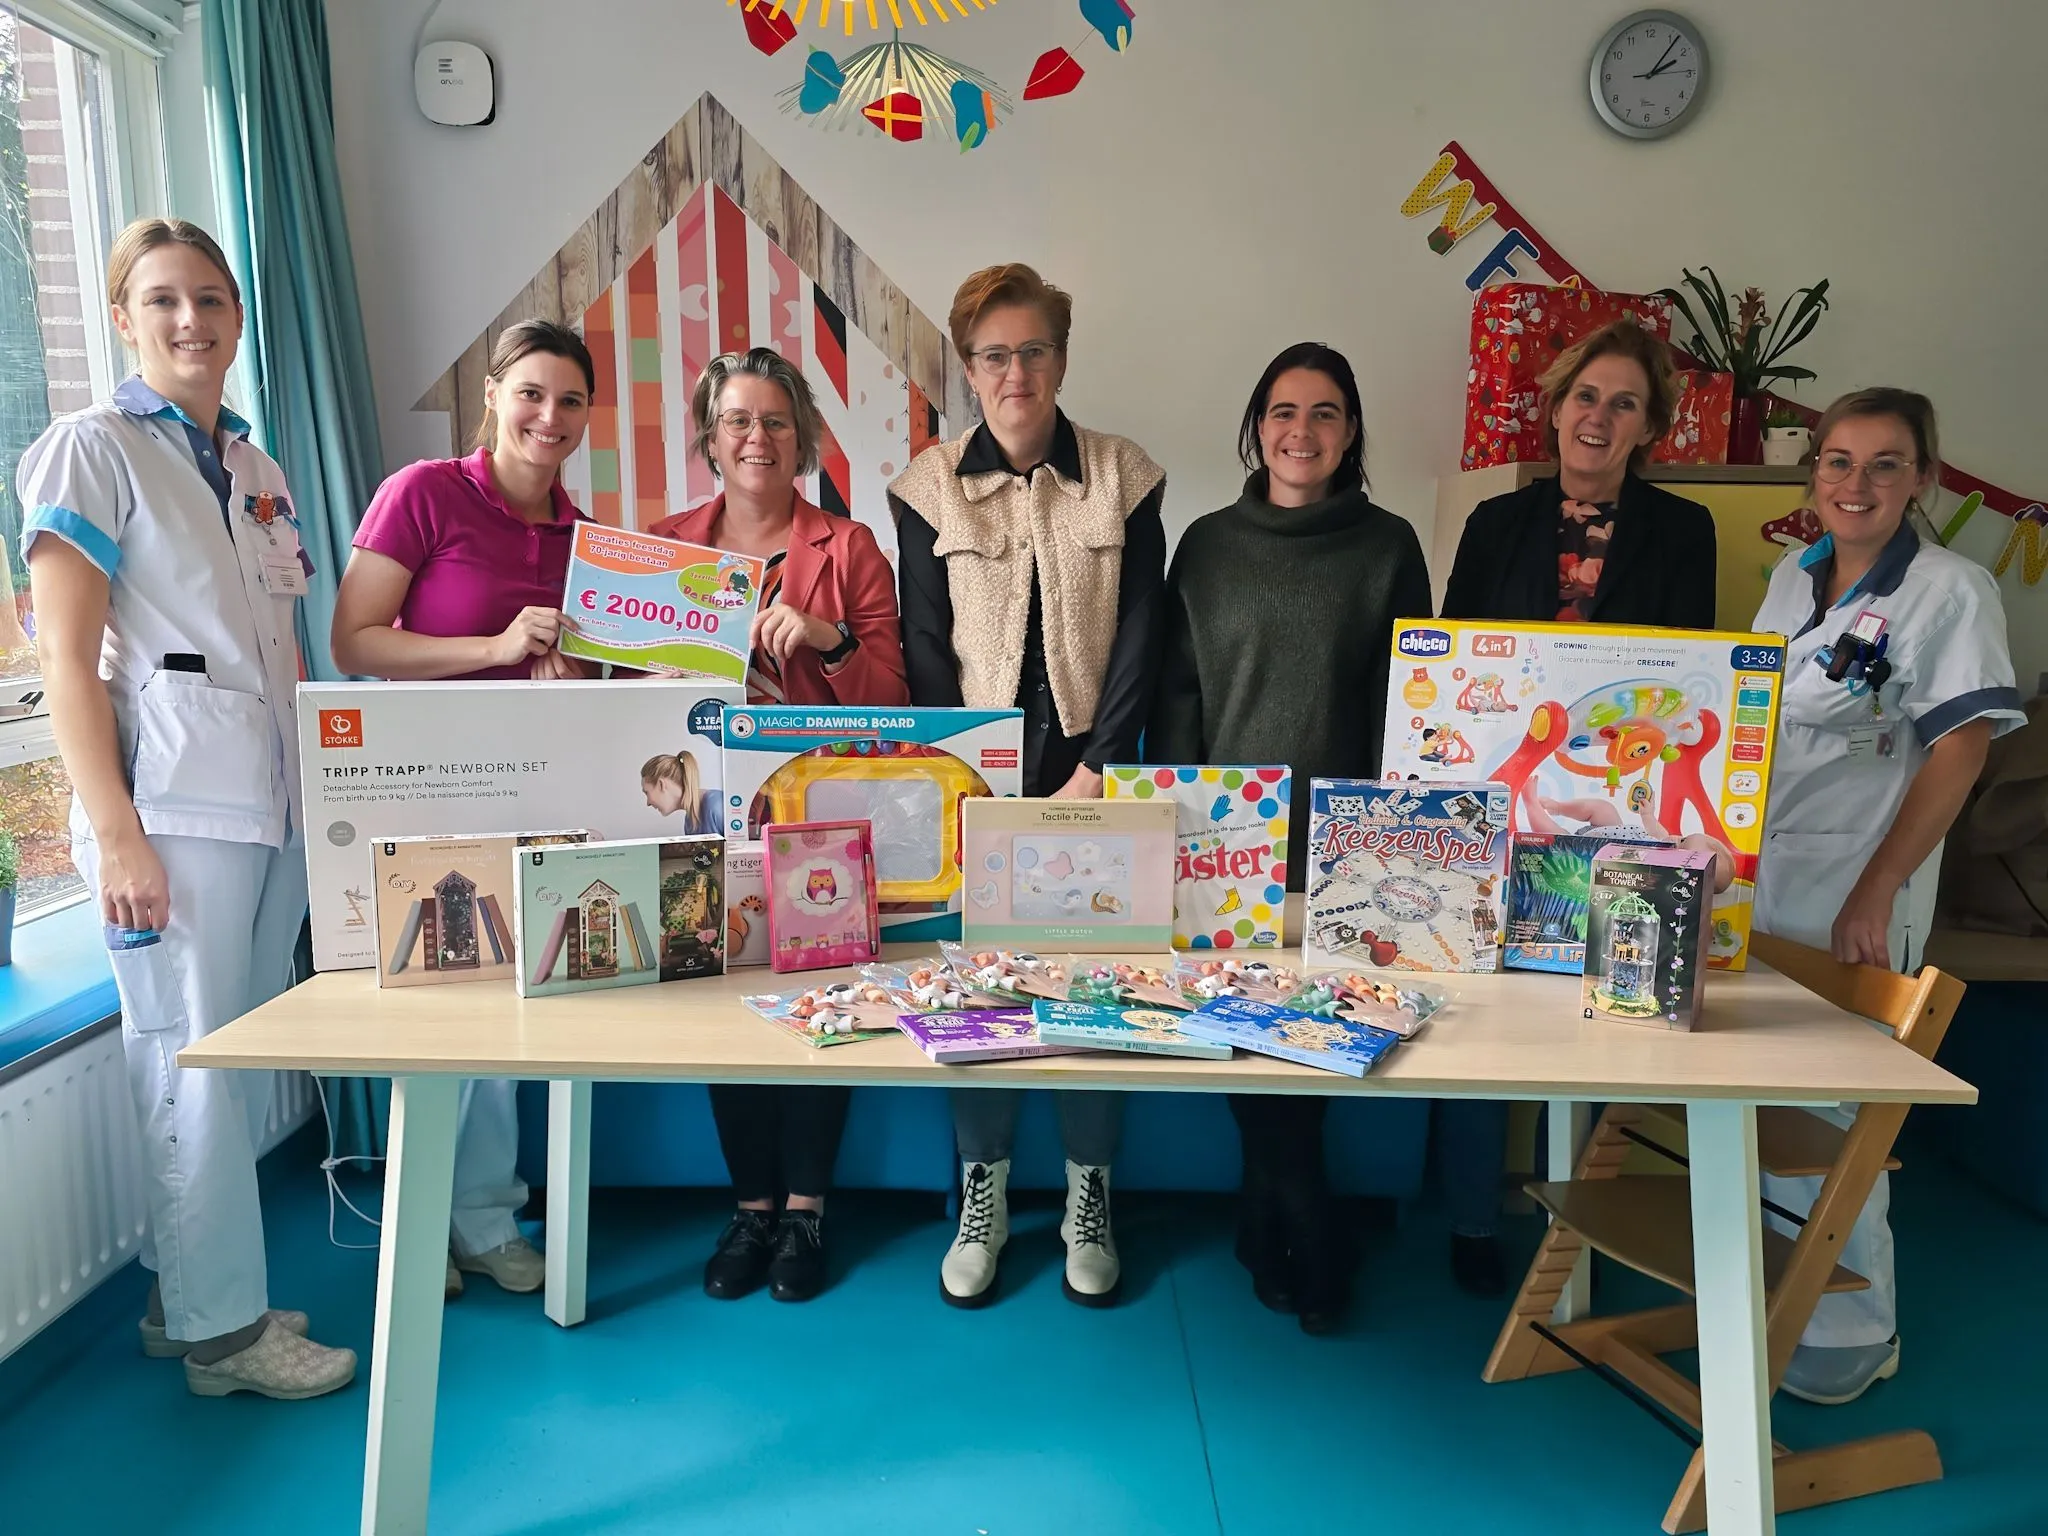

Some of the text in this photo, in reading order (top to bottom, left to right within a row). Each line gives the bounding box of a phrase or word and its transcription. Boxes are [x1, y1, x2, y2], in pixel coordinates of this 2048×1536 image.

[1645, 28, 1656, 38] 12
[1627, 36, 1636, 46] 11
[1667, 34, 1673, 43] 1
[1612, 51, 1623, 60] 10
[1680, 47, 1687, 57] 2
[1605, 73, 1612, 83] 9
[1686, 70, 1693, 79] 3
[1612, 94, 1619, 103] 8
[1678, 90, 1685, 99] 4
[1625, 108, 1632, 118] 7
[1664, 106, 1671, 116] 5
[1643, 113, 1650, 123] 6
[586, 530, 675, 558] Donaties feestdag
[590, 544, 668, 568] 70-jarig bestaan
[683, 584, 745, 609] De Flipjes
[579, 588, 720, 635] € 2000,00
[578, 615, 590, 624] Ten
[591, 617, 606, 627] bate
[1401, 633, 1448, 652] chicco
[1476, 637, 1513, 655] 4 in 1
[1553, 642, 1588, 650] GROWING
[1589, 644, 1616, 654] through
[1617, 645, 1631, 655] play
[1558, 655, 1584, 664] Giocare
[1624, 658, 1636, 667] per
[1637, 658, 1679, 668] CRESCERE!
[1741, 649, 1776, 665] 3-36
[1740, 676, 1748, 687] 4
[695, 716, 722, 725] 3 YEA
[759, 716, 916, 729] MAGIC DRAWING BOARD
[1414, 719, 1421, 728] 2
[324, 735, 359, 745] STOKKE
[323, 761, 549, 778] TRIPP TRAPP® NEWBORN SET
[323, 779, 493, 792] Detachable Accessory for Newborn Comfort
[323, 794, 345, 803] From
[346, 793, 365, 802] birth
[366, 795, 377, 804] up
[378, 793, 387, 801] to
[388, 792, 395, 801] 9
[395, 792, 406, 802] kg
[407, 791, 415, 800] //
[416, 791, 427, 800] De
[428, 790, 436, 799] la
[437, 789, 474, 799] naissance
[502, 789, 508, 797] 9
[508, 789, 518, 798] kg
[1041, 812, 1102, 821] Tactile Puzzle
[1358, 813, 1468, 829] Hollands & Oergezellig
[726, 858, 763, 870] ng tiger
[1603, 870, 1645, 882] BOTANICAL
[391, 879, 411, 889] DIY
[1610, 878, 1637, 887] TOWER
[337, 951, 364, 959] Designed
[1521, 941, 1554, 960] SEA
[1132, 1042, 1149, 1051] PUZZLE
